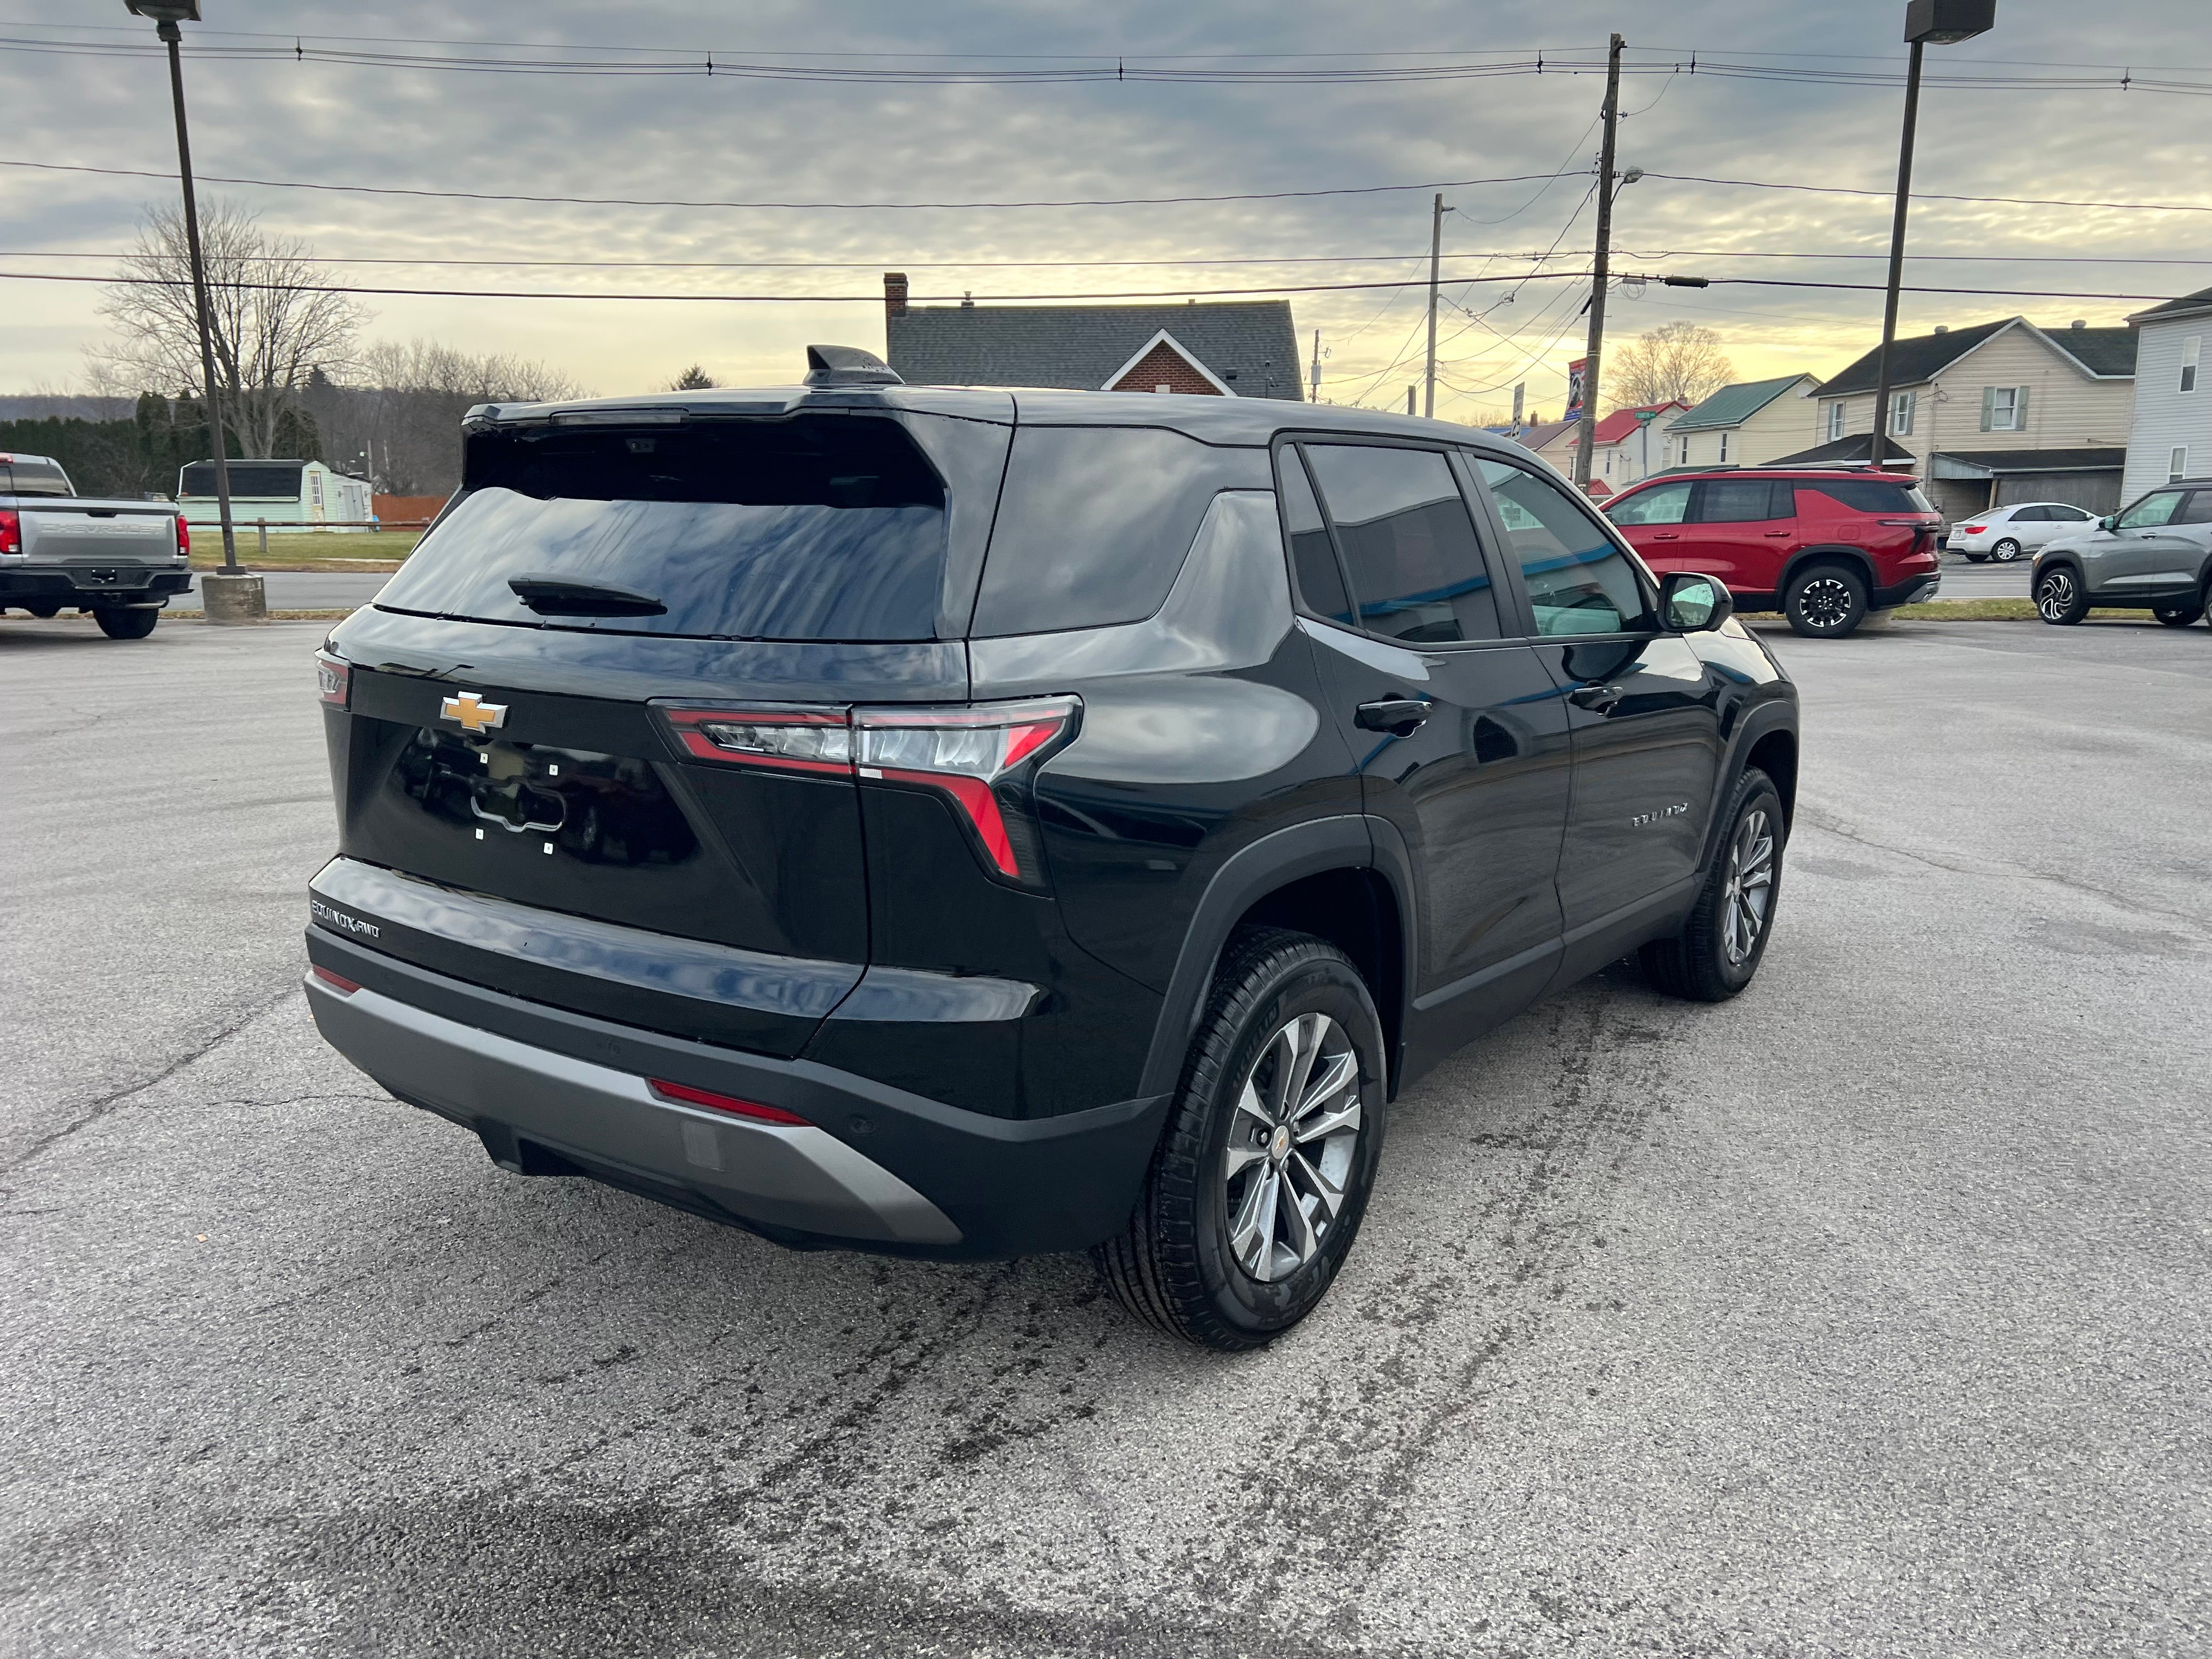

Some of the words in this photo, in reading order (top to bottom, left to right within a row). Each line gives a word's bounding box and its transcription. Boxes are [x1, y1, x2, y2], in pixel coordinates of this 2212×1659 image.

[1511, 415, 1521, 437] 25
[41, 523, 166, 534] CHEVROLET
[312, 900, 356, 932] EQUINOX
[357, 920, 379, 938] AWD
